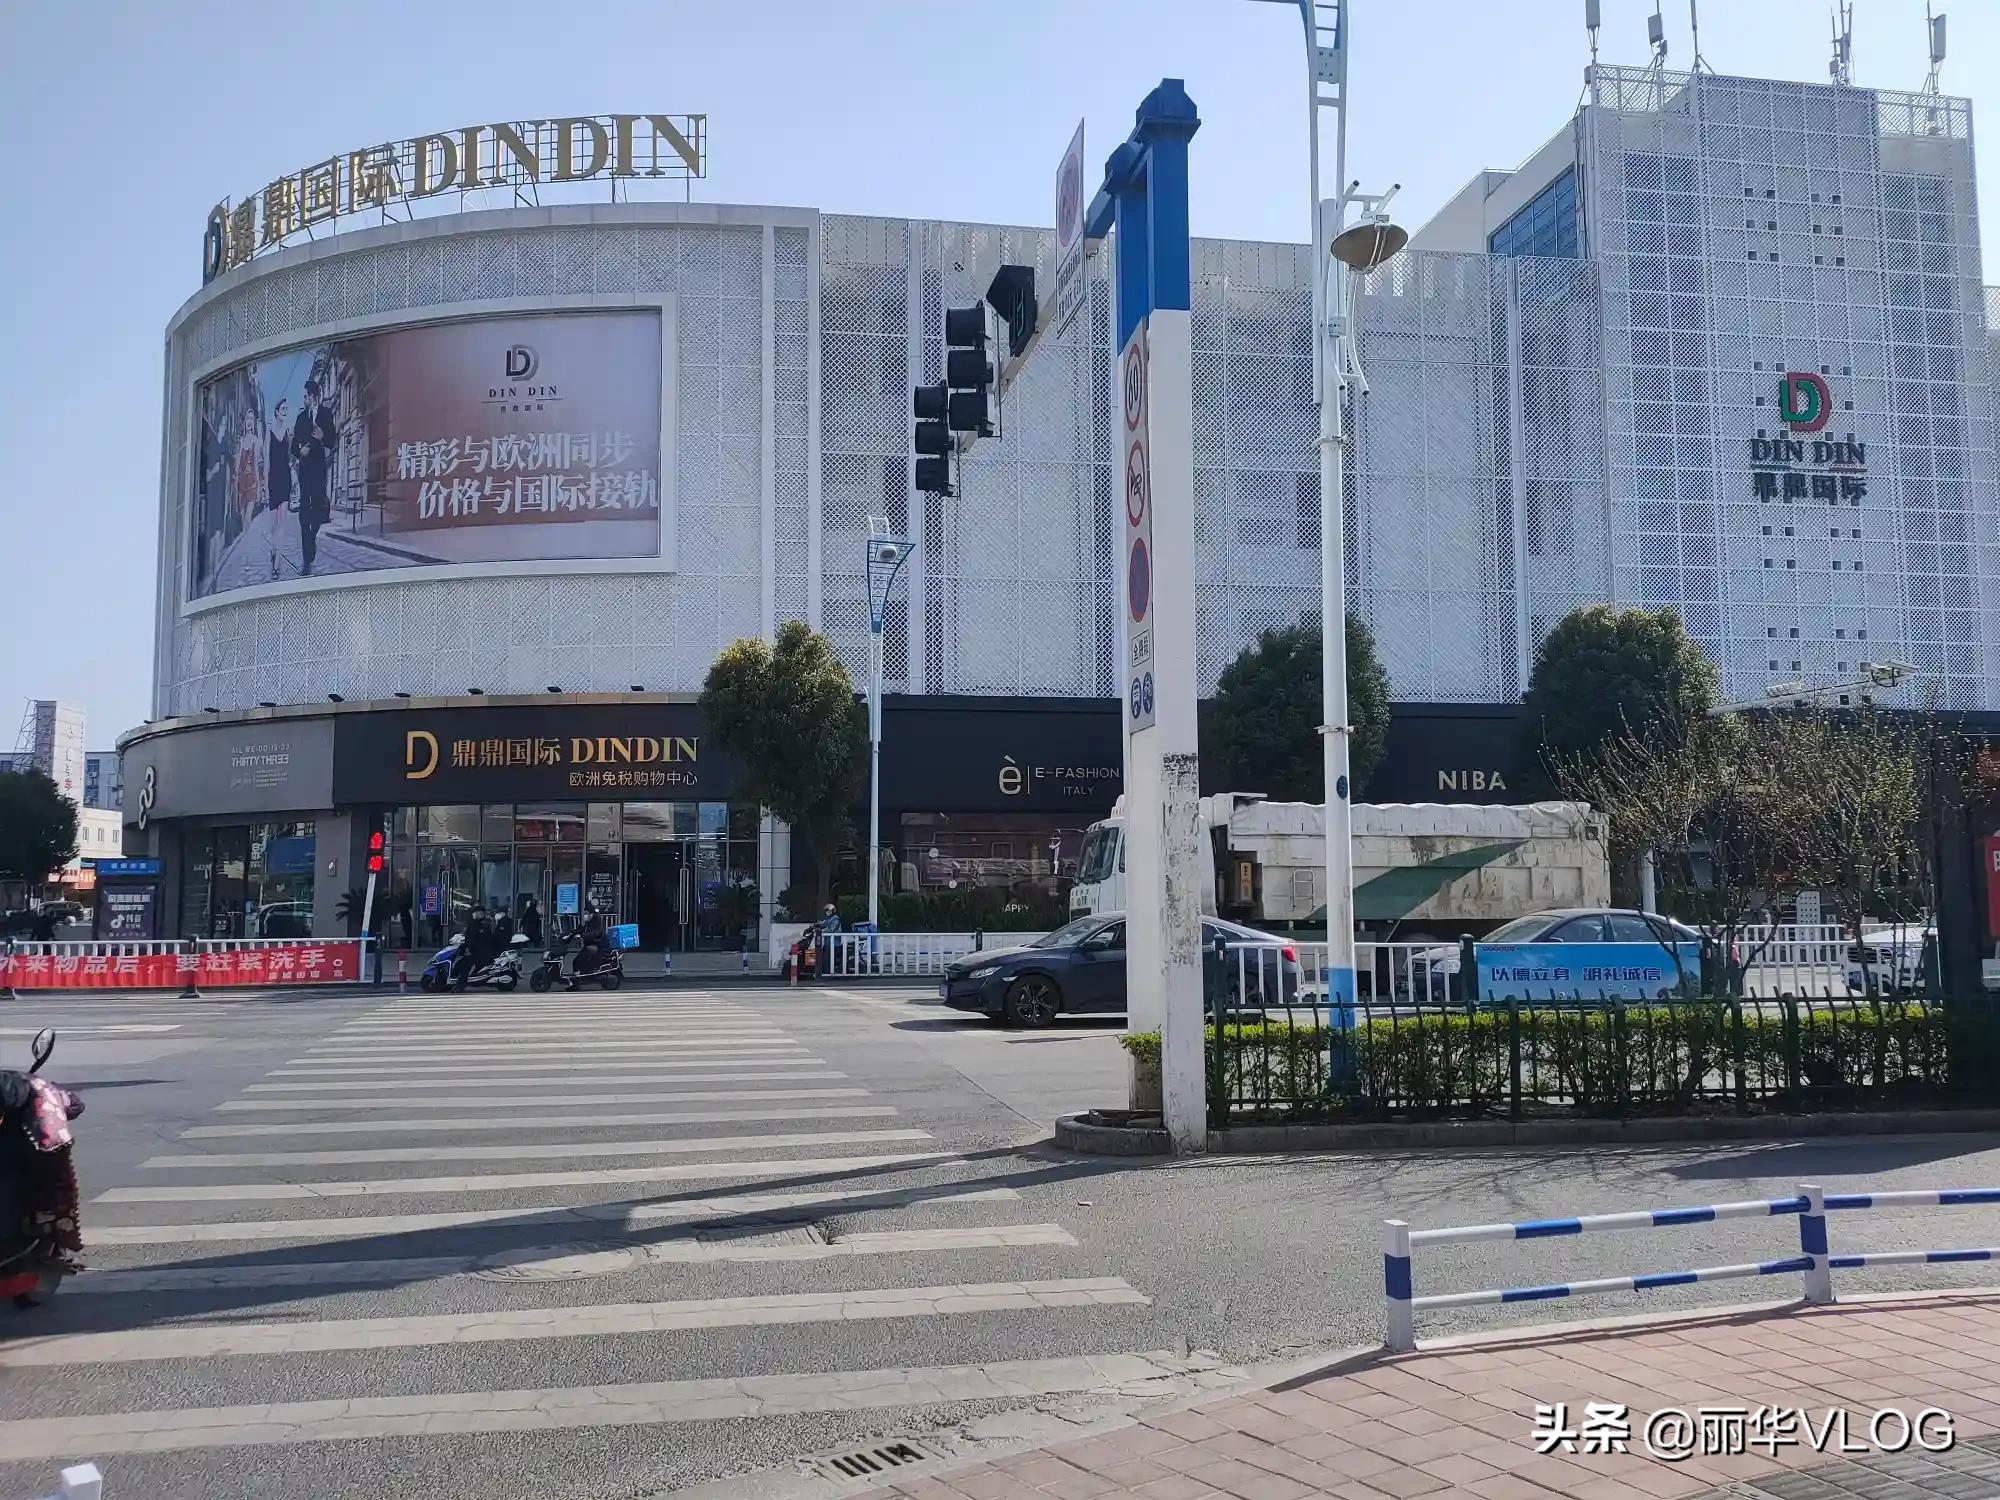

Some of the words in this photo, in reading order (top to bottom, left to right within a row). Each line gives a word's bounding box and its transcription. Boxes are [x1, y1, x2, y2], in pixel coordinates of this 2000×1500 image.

[408, 114, 706, 197] DINDIN
[489, 387, 517, 398] DIN
[528, 385, 557, 396] DIN
[396, 430, 635, 481] 精彩与欧洲同步
[1751, 438, 1804, 463] DIN
[1811, 441, 1867, 465] DIN
[416, 468, 659, 520] 价格与国际接轨
[451, 737, 561, 768] 鼎鼎国际
[569, 736, 699, 764] DINDIN
[569, 770, 699, 788] 欧洲免税购物中心
[1035, 766, 1121, 779] E-FASHION
[1438, 770, 1507, 791] NIBA
[1063, 785, 1096, 797] ITALY
[1490, 967, 1569, 982] 以德立身
